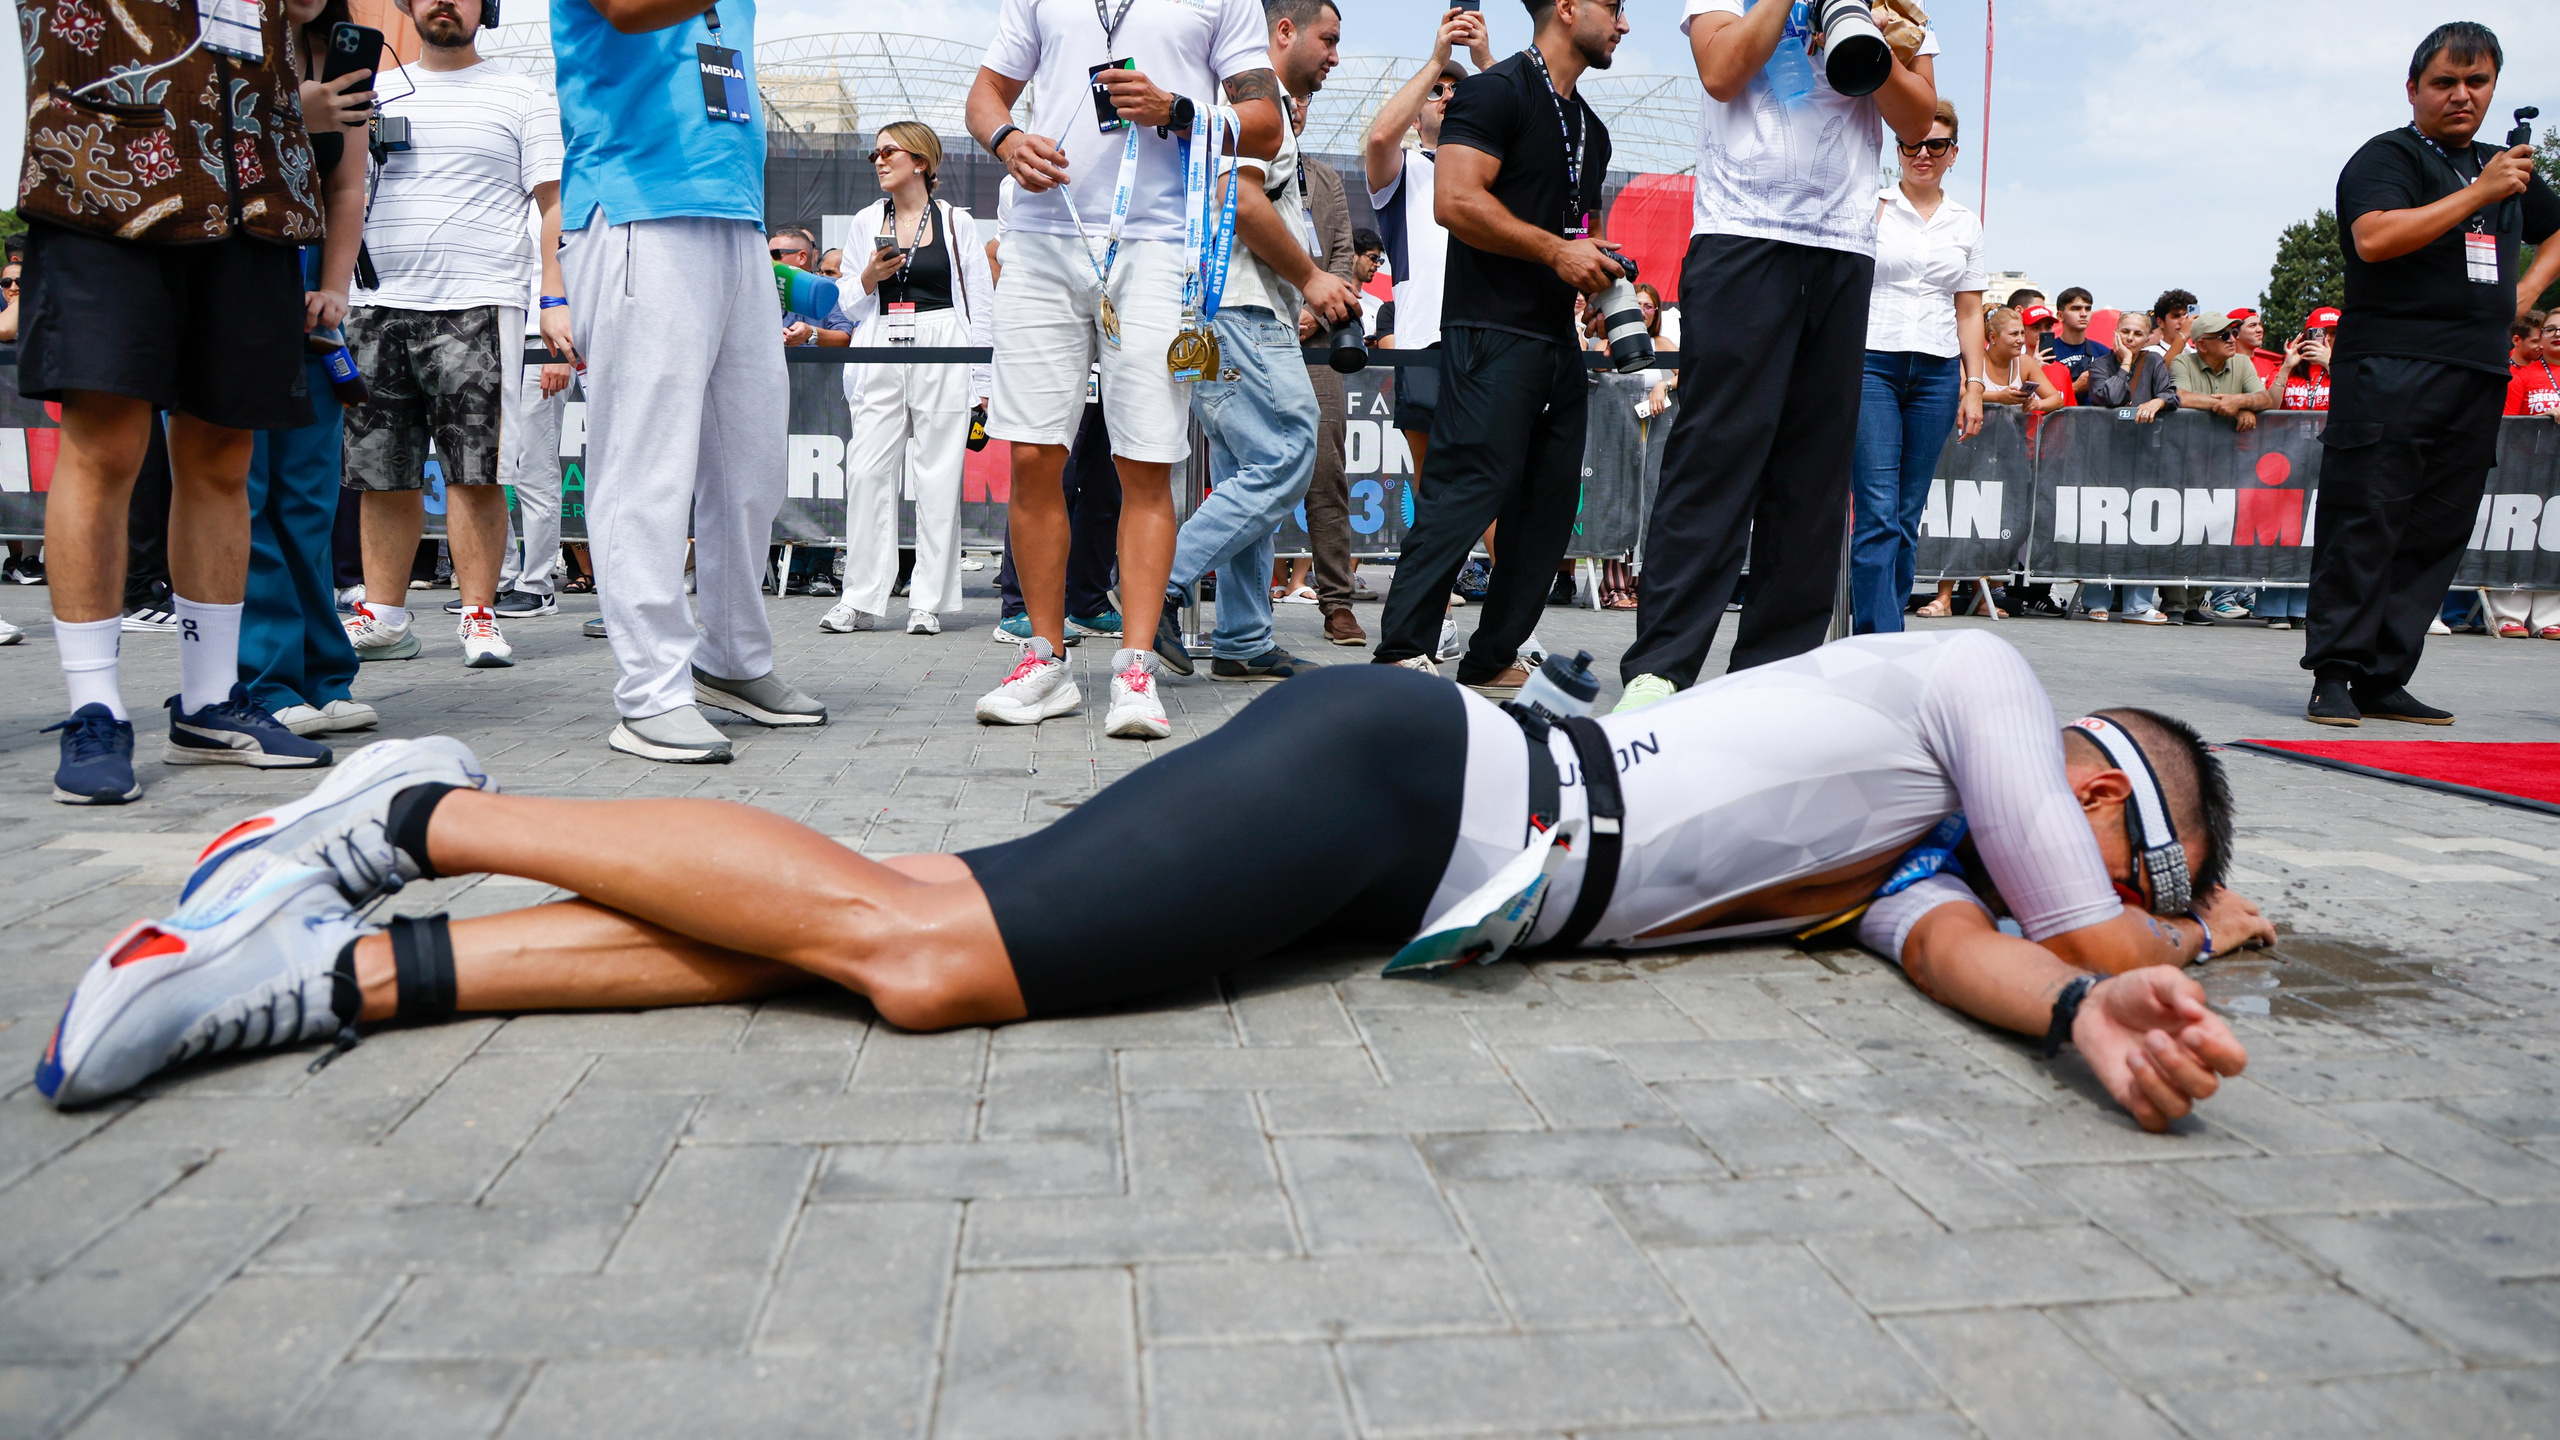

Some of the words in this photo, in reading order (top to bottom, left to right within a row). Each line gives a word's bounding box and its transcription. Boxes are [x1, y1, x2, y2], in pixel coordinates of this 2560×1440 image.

[700, 62, 744, 80] MEDIA
[1212, 228, 1231, 295] ANYTHING
[1222, 211, 1233, 225] IS
[2053, 452, 2318, 547] IRONM
